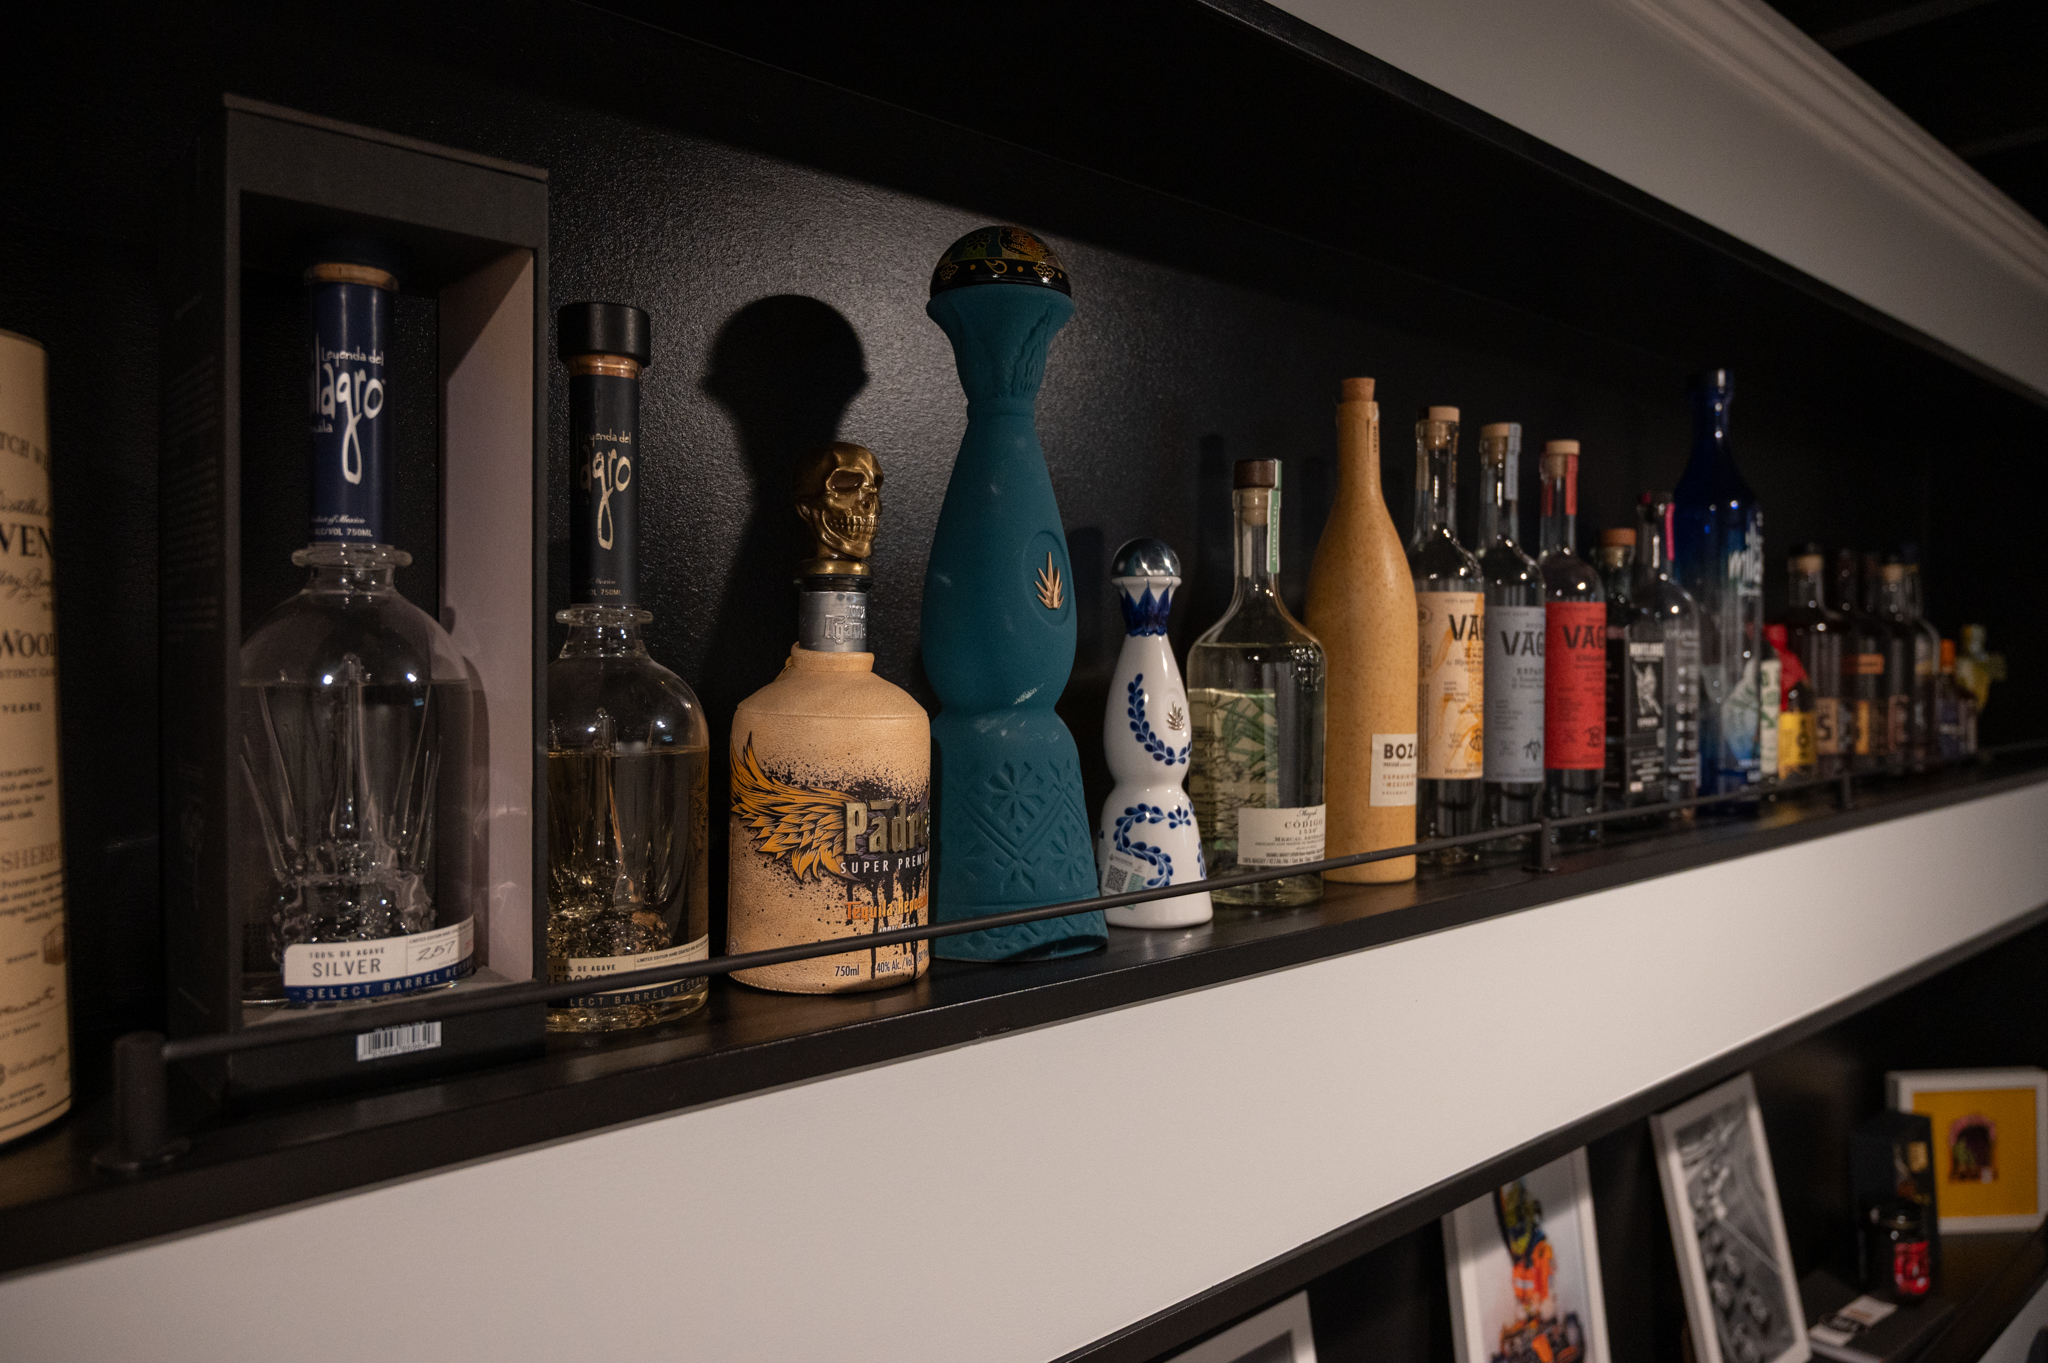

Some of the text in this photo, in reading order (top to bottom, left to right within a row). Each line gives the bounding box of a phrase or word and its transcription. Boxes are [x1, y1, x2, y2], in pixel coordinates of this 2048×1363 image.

[321, 345, 384, 368] Leyenda del
[619, 430, 632, 446] del
[346, 527, 373, 538] 750ML
[840, 860, 879, 874] SUPER
[845, 899, 893, 922] Tequila
[309, 950, 335, 959] 100%
[357, 946, 385, 956] AGAVE
[312, 958, 381, 978] SILVER
[835, 964, 860, 977] 750ml
[877, 962, 890, 973] 40%
[306, 984, 372, 999] SELECT
[383, 972, 439, 991] BARREL
[614, 989, 665, 1005] BARREL
